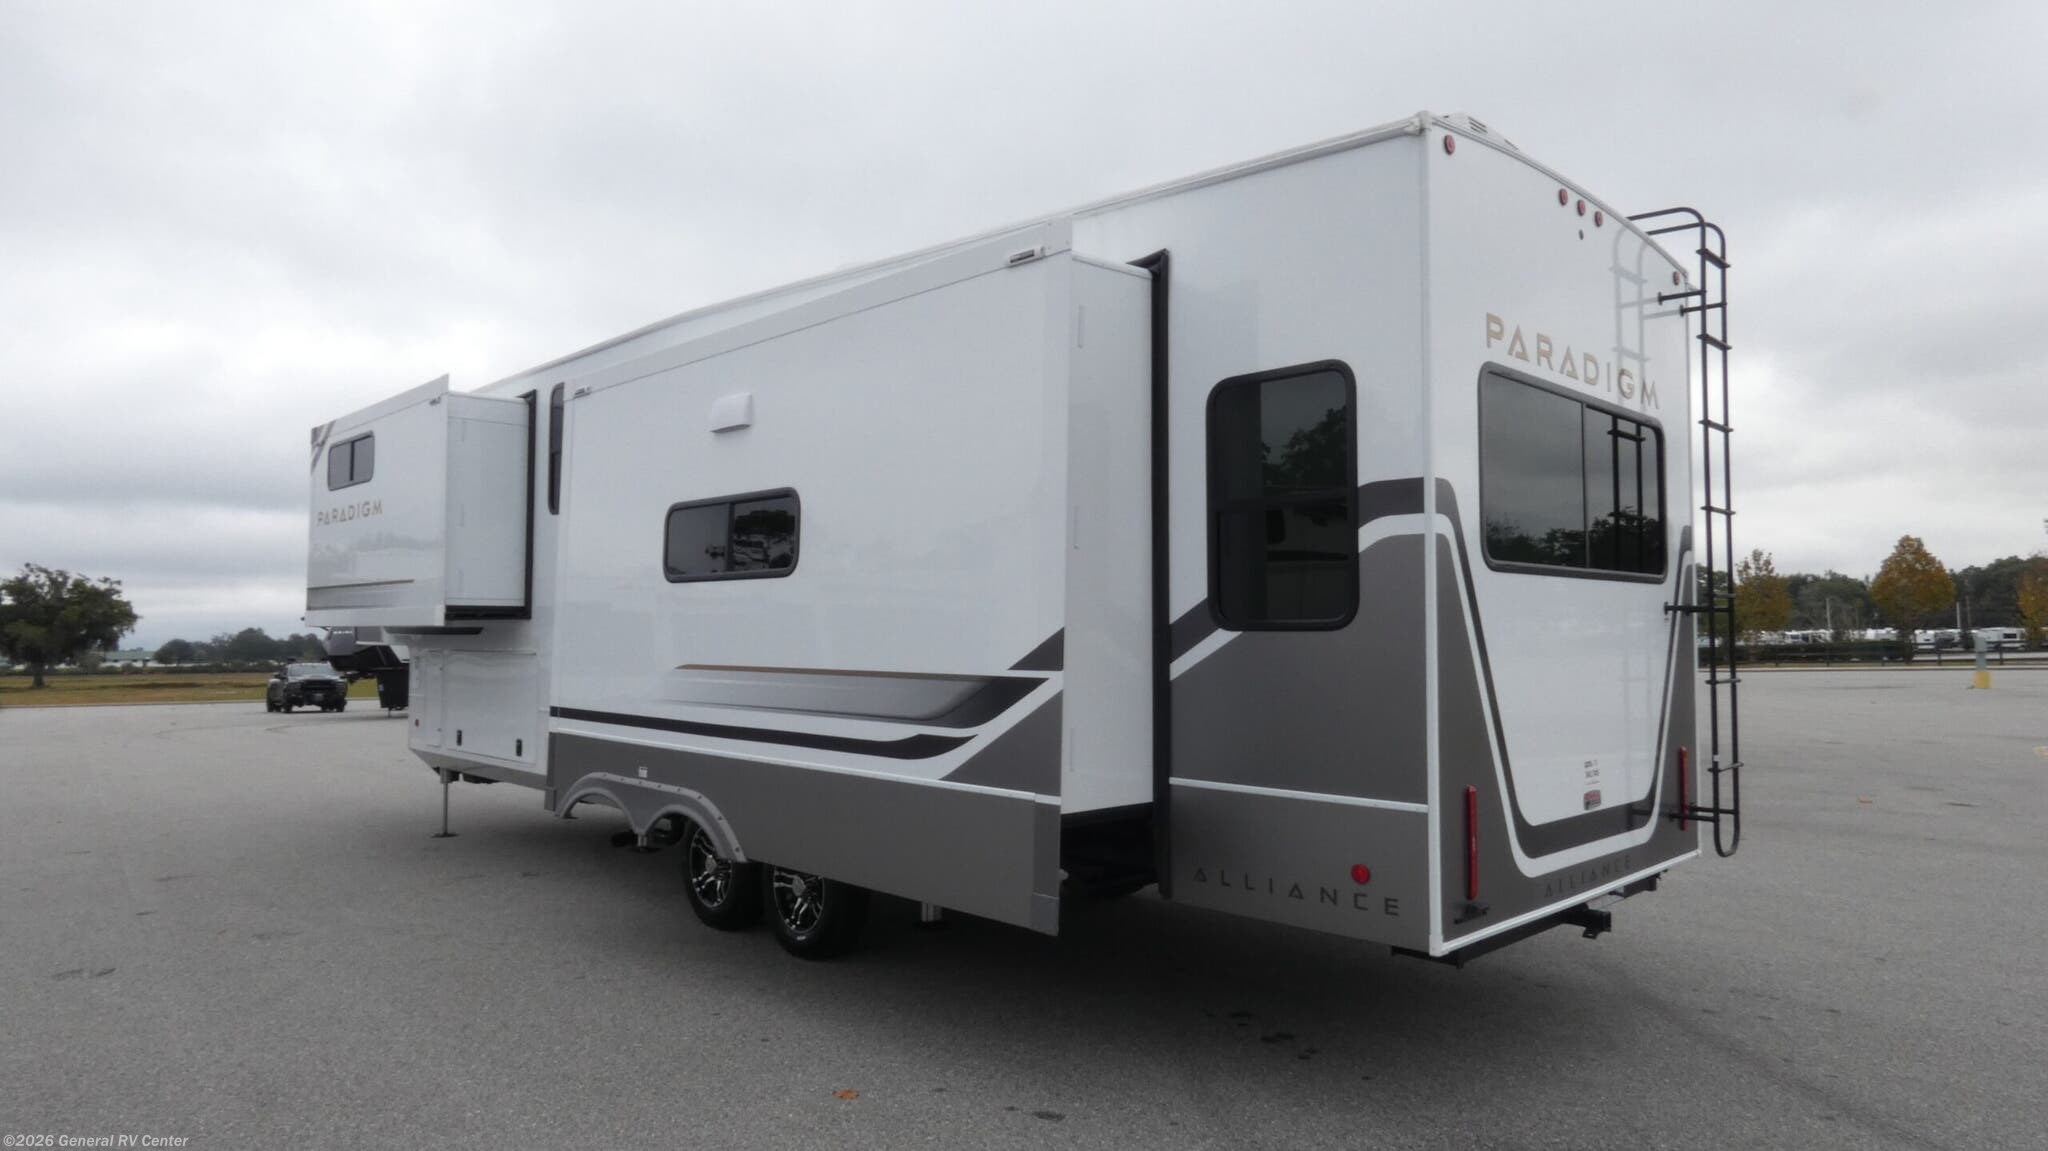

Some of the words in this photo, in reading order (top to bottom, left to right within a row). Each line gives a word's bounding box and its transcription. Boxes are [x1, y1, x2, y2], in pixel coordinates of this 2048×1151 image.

[1486, 312, 1660, 410] PARADIGM
[316, 499, 384, 526] PARADIGM
[1193, 867, 1400, 917] ALLIANCE
[1545, 854, 1631, 898] ALLIANCE
